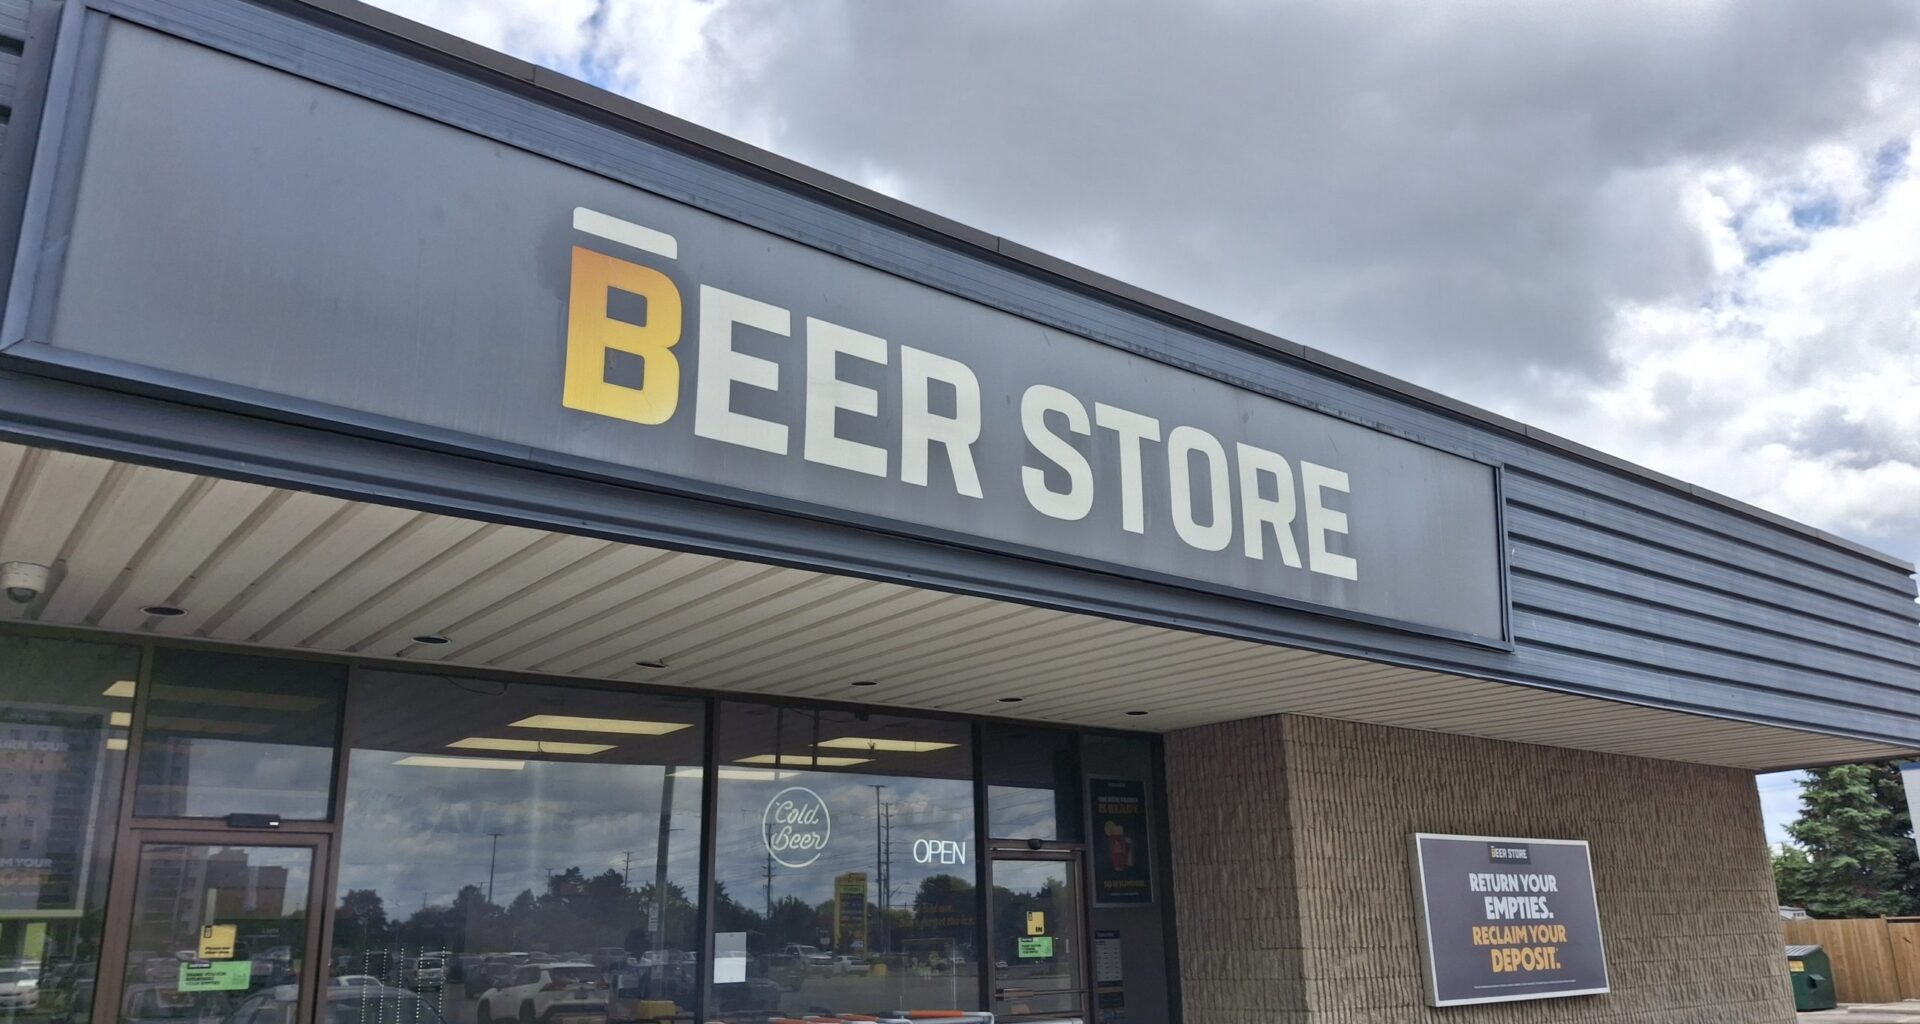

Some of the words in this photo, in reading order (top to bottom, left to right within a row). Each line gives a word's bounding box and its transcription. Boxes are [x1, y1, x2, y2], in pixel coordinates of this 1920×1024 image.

[562, 243, 983, 499] BEER
[1021, 384, 1358, 581] STORE
[775, 801, 819, 824] Cold
[771, 825, 823, 850] Beer
[16, 858, 53, 868] YOUR
[913, 839, 966, 865] OPEN
[1508, 848, 1528, 859] STORE
[1469, 873, 1519, 892] RETURN
[1520, 874, 1558, 892] YOUR
[1484, 896, 1555, 920] EMPTIES.
[1472, 925, 1528, 945] RECLAIM
[1528, 924, 1567, 943] YOUR
